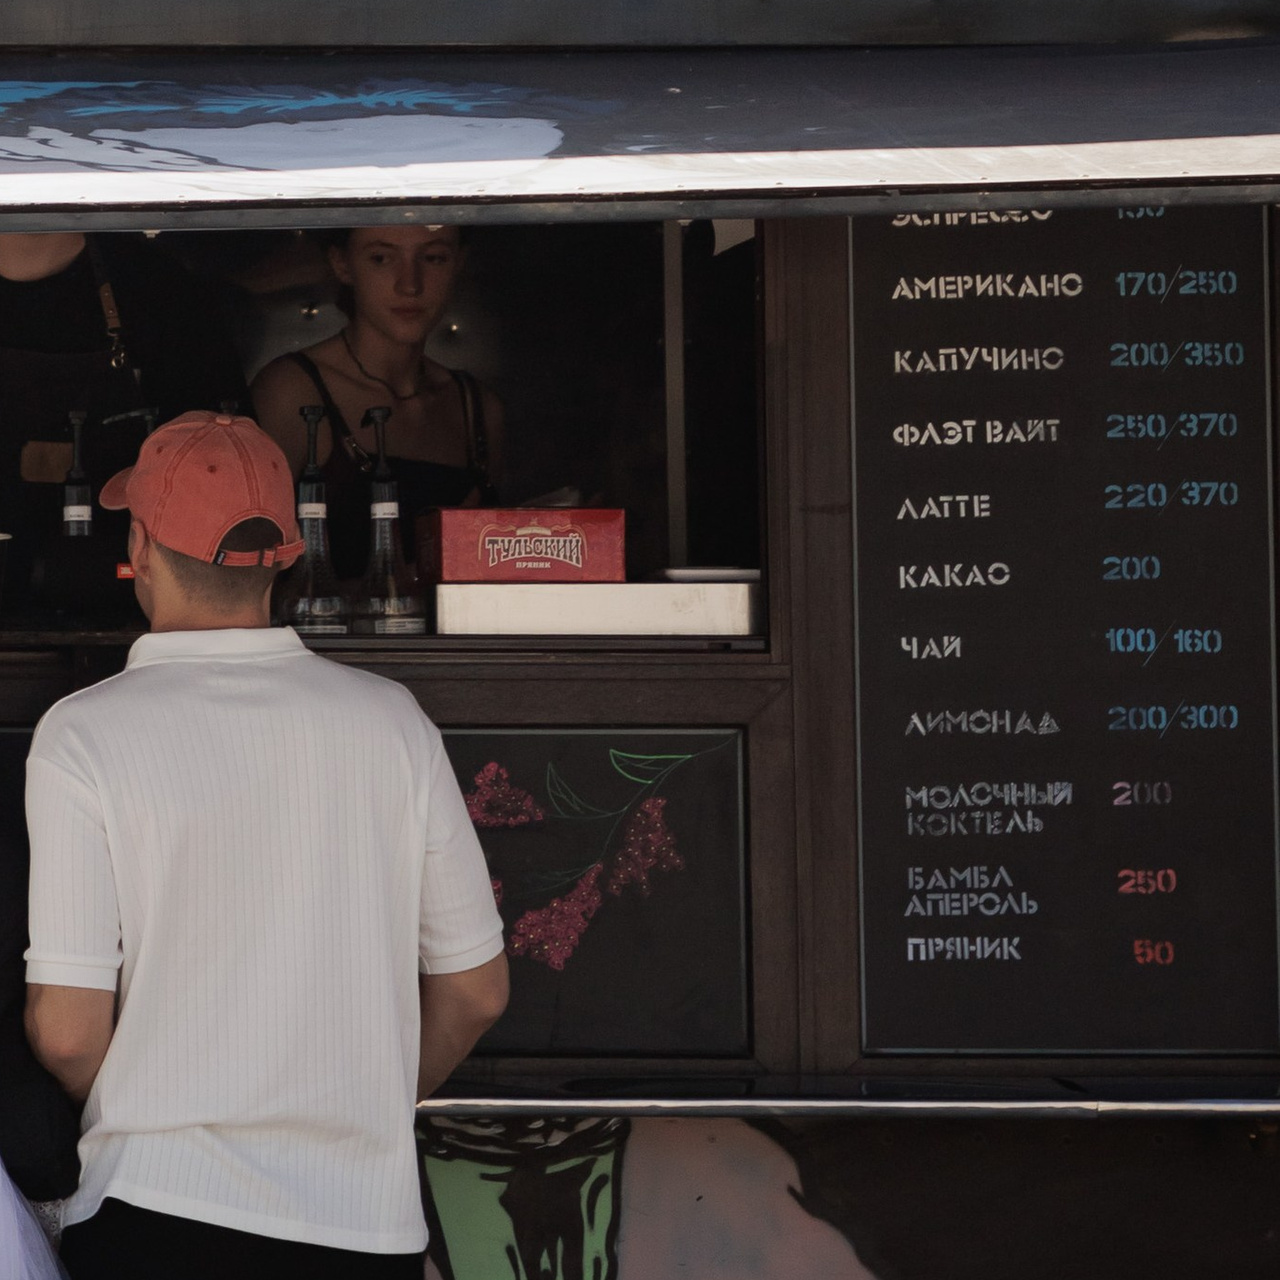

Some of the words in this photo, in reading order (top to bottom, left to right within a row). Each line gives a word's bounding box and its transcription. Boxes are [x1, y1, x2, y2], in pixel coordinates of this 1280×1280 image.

[892, 273, 1082, 299] АМЕРИКАНО
[1116, 265, 1237, 303] 170/250
[895, 347, 1063, 372] КАПУЧИНО
[1110, 341, 1244, 372] 200/350
[893, 420, 976, 446] ФЛЭТ
[986, 420, 1059, 443] ВАЙТ
[1107, 413, 1237, 451] 250/370
[897, 495, 990, 519] ЛАТТЕ
[1105, 480, 1238, 516] 220/370
[485, 533, 582, 568] ТУЛЬСКИЙ
[516, 561, 551, 569] ПРЯНИК
[900, 563, 1010, 589] КАКАО
[1103, 556, 1161, 580] 200
[901, 636, 960, 658] ЧАЙ
[905, 709, 1059, 735] ЛИМОНАД
[906, 782, 1072, 809] МОЛОЧНЫЙ
[1113, 781, 1172, 806] 200
[908, 810, 1044, 835] КОКТЕЛЬ
[908, 866, 1013, 890] БАМБЛ
[1118, 869, 1176, 893] 250
[904, 892, 1039, 917] АПЕРОЛЬ
[908, 937, 1021, 961] ПРЯНИК
[1134, 940, 1174, 964] 50
